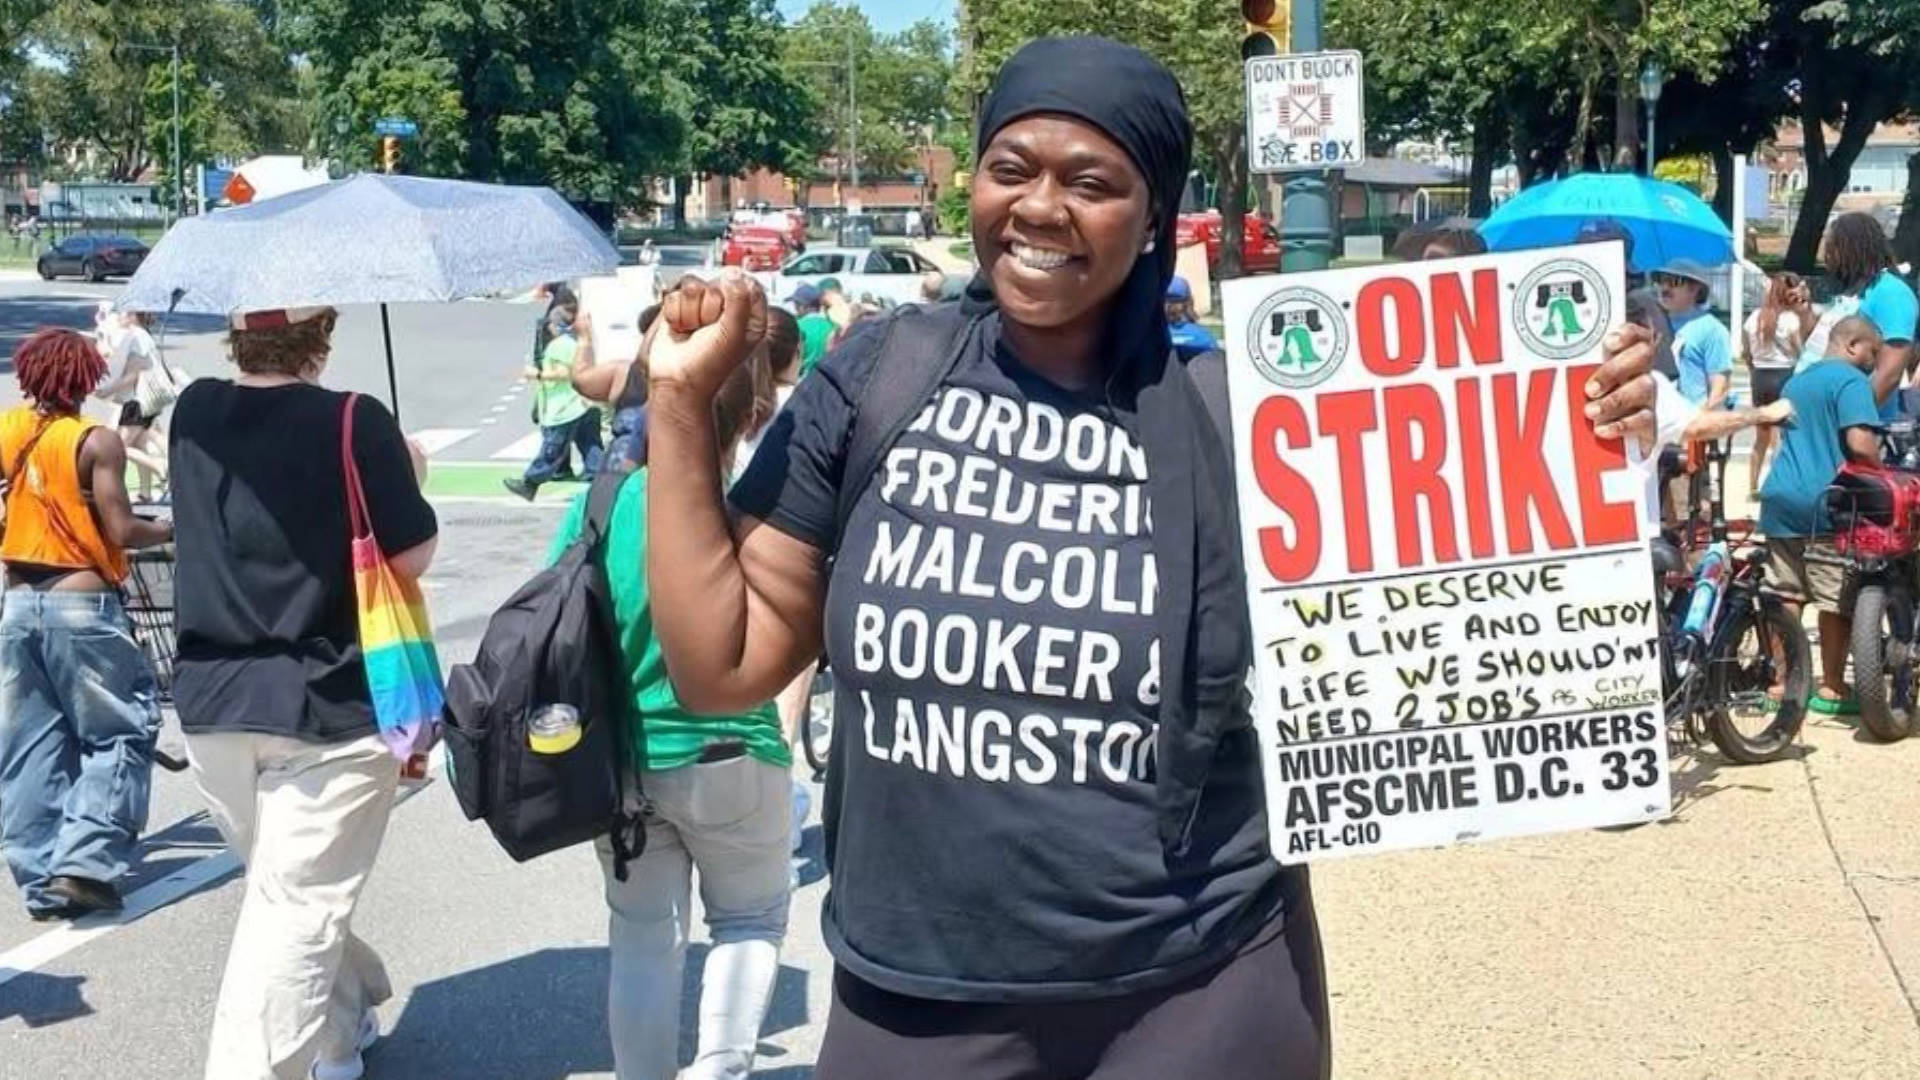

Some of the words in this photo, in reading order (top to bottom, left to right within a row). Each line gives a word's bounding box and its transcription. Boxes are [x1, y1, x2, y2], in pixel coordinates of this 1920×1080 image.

[1253, 61, 1295, 83] DONT
[1302, 57, 1354, 80] BLOCK
[1310, 139, 1354, 162] BOX
[1355, 268, 1503, 377] ON
[881, 447, 1152, 536] FREDERI
[1251, 362, 1639, 583] STRIKE
[1292, 587, 1363, 629] WE
[1383, 564, 1567, 612] DESERVE
[854, 603, 1121, 702] BOOKER
[1266, 636, 1323, 668] TO
[1464, 613, 1541, 641] AND
[1557, 600, 1652, 632] ENJOY
[1396, 654, 1459, 690] WE
[1585, 689, 1660, 710] WORKER
[1595, 674, 1644, 693] CITY
[1276, 707, 1372, 746] NEED
[1394, 693, 1425, 729] 2
[1435, 685, 1542, 723] JOB'S
[1279, 731, 1473, 783] MUNICIPAL
[1482, 711, 1657, 759] WORKERS
[1285, 766, 1479, 828] AFSCME
[1493, 756, 1584, 804] D.C.
[1601, 748, 1660, 792] 33
[1287, 821, 1381, 855] AFL-CIO
